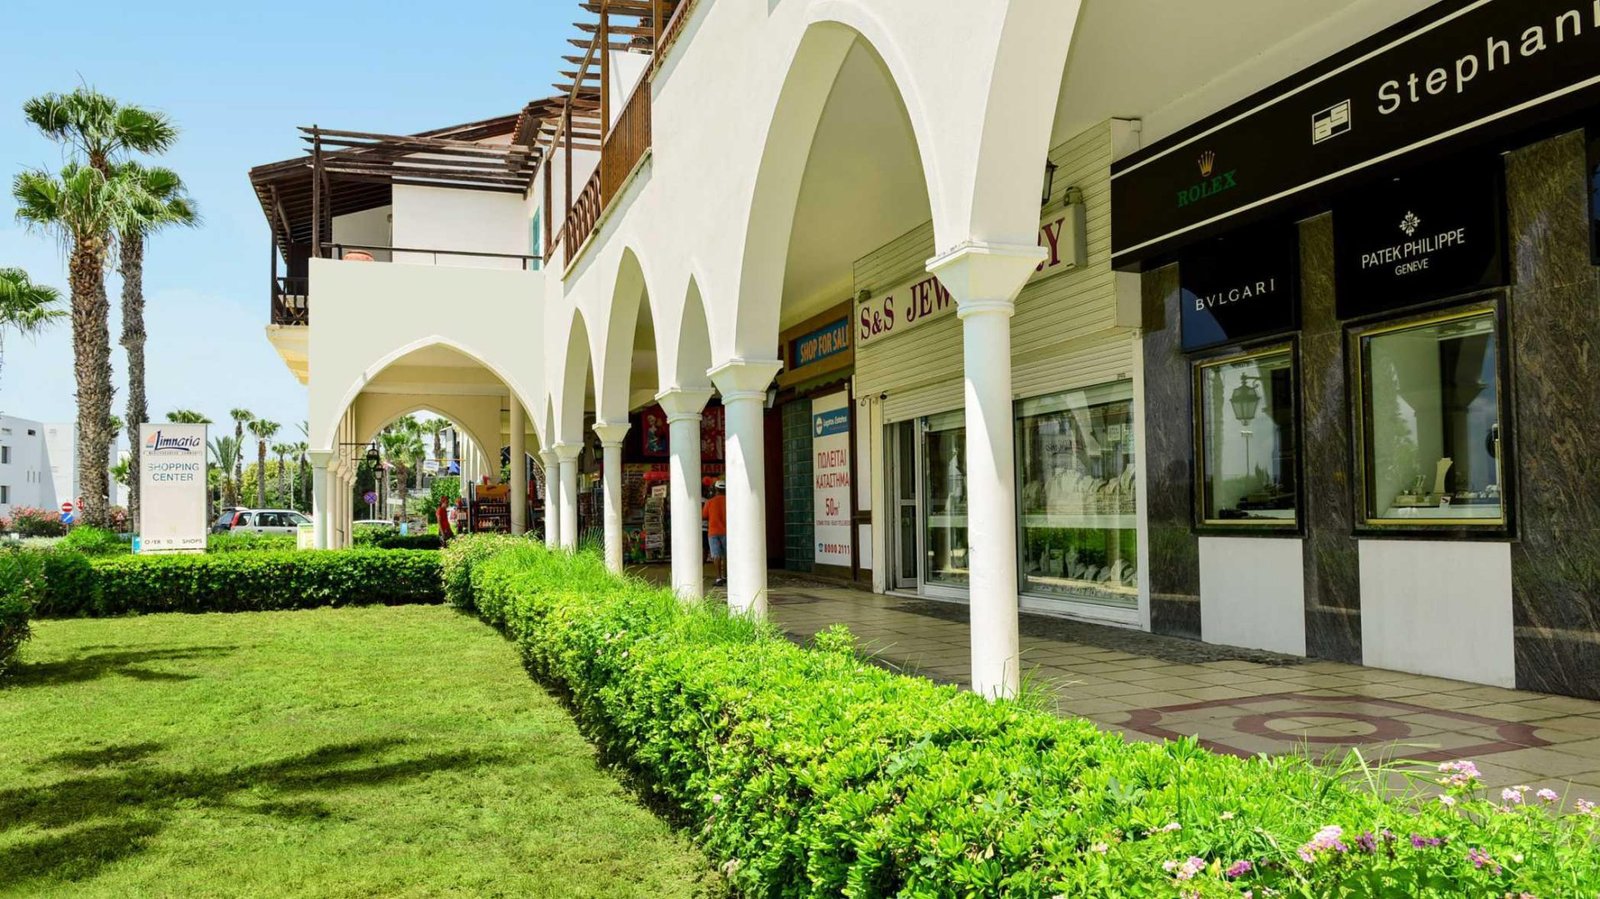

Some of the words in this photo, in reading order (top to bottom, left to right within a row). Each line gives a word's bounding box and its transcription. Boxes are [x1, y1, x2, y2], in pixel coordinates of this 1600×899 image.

[1176, 168, 1238, 208] ROLEX
[1361, 244, 1402, 270] PATEK
[1403, 227, 1466, 259] PHILIPPE
[1394, 257, 1430, 276] GENEVE
[1195, 277, 1276, 311] BVLGARI
[861, 295, 895, 340] S&S
[800, 338, 818, 364] SHOP
[818, 332, 833, 357] FOR
[154, 429, 201, 451] Limnaria
[147, 462, 200, 472] SHOPPING
[152, 472, 194, 482] CENTER
